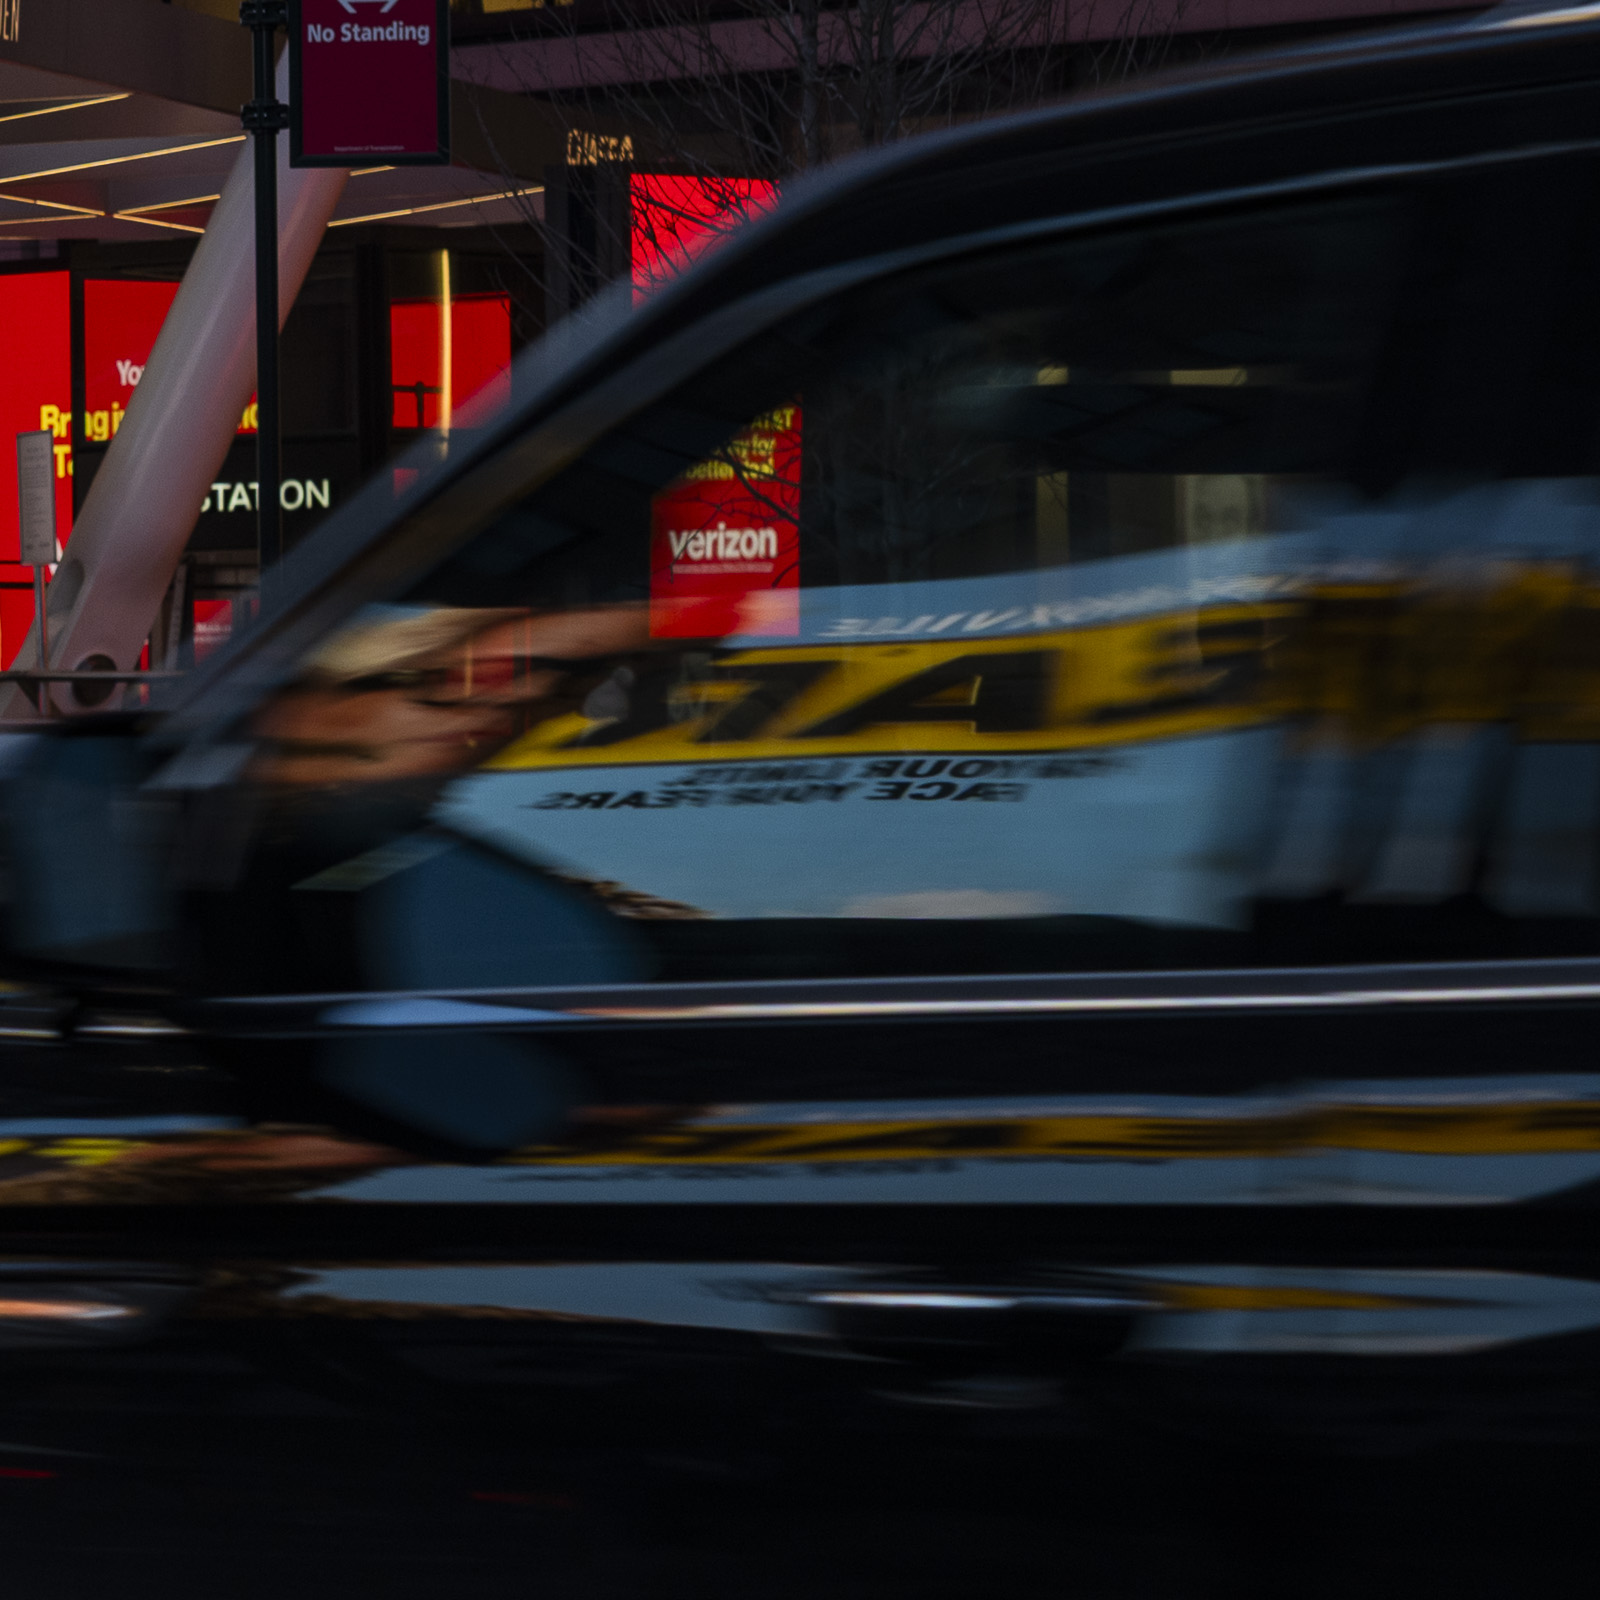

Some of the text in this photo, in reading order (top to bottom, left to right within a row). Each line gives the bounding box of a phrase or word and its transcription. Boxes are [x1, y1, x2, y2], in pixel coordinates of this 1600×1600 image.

[307, 20, 430, 46] No Standing
[116, 359, 145, 387] Yo
[201, 478, 330, 513] TATON
[669, 521, 778, 561] verizon
